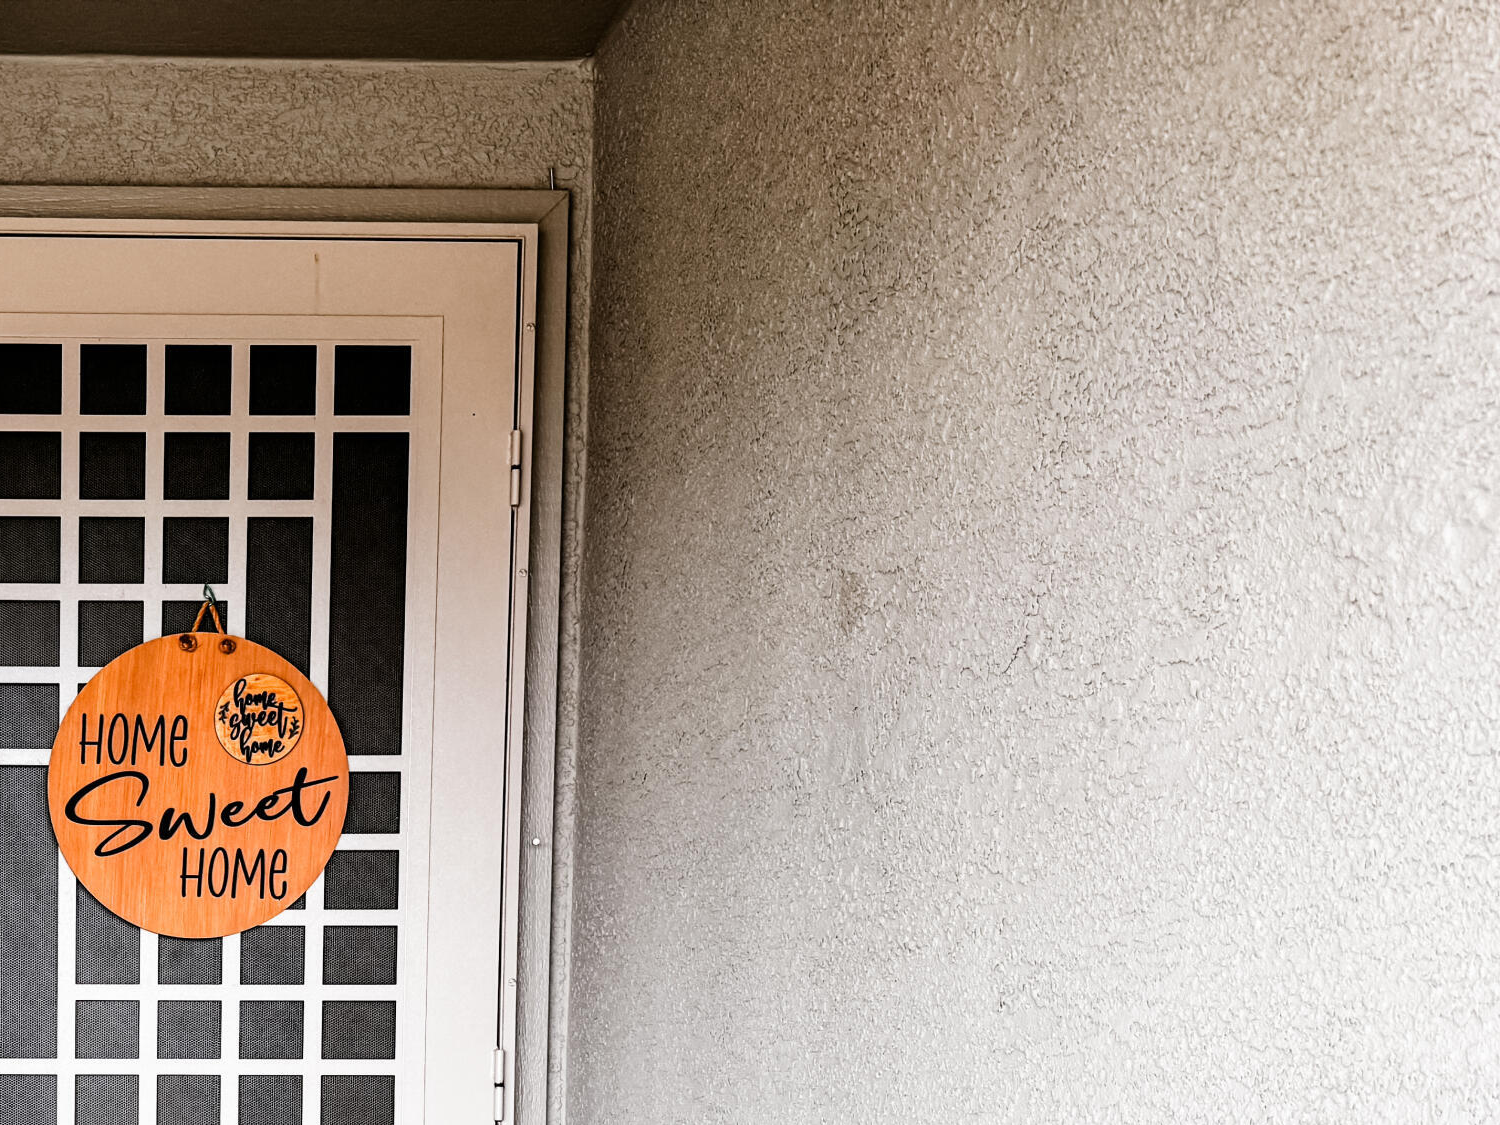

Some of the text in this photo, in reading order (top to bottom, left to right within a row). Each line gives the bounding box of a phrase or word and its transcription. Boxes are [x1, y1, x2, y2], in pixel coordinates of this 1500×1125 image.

[233, 678, 276, 710] home
[229, 701, 298, 740] sweet
[240, 726, 285, 762] home
[64, 766, 339, 857] Sweet
